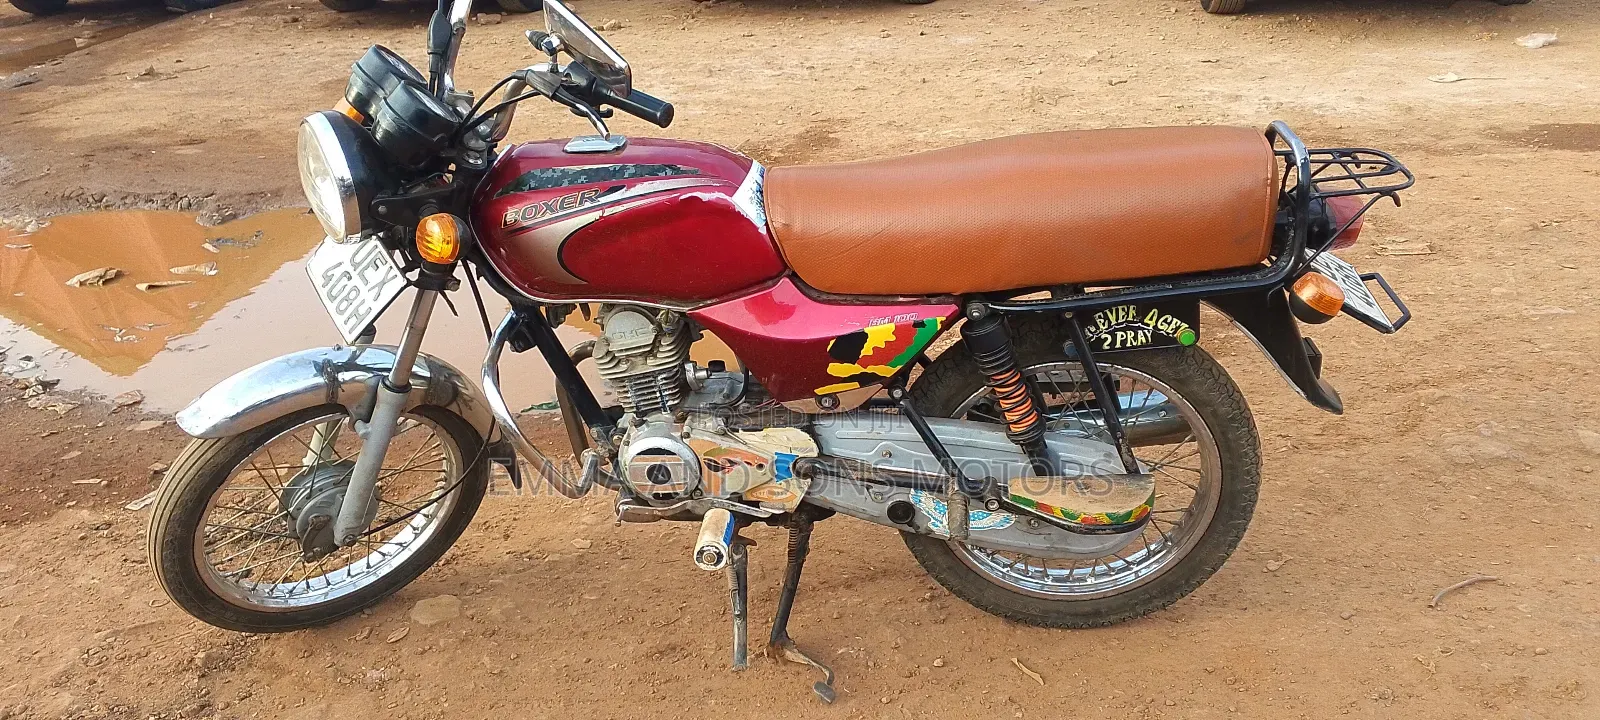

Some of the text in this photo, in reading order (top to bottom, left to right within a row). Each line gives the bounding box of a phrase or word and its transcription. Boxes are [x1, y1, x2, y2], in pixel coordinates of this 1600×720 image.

[501, 189, 601, 228] BOXER
[350, 240, 398, 302] UEX
[893, 312, 919, 323] 100
[1101, 329, 1153, 350] 2 PRAY
